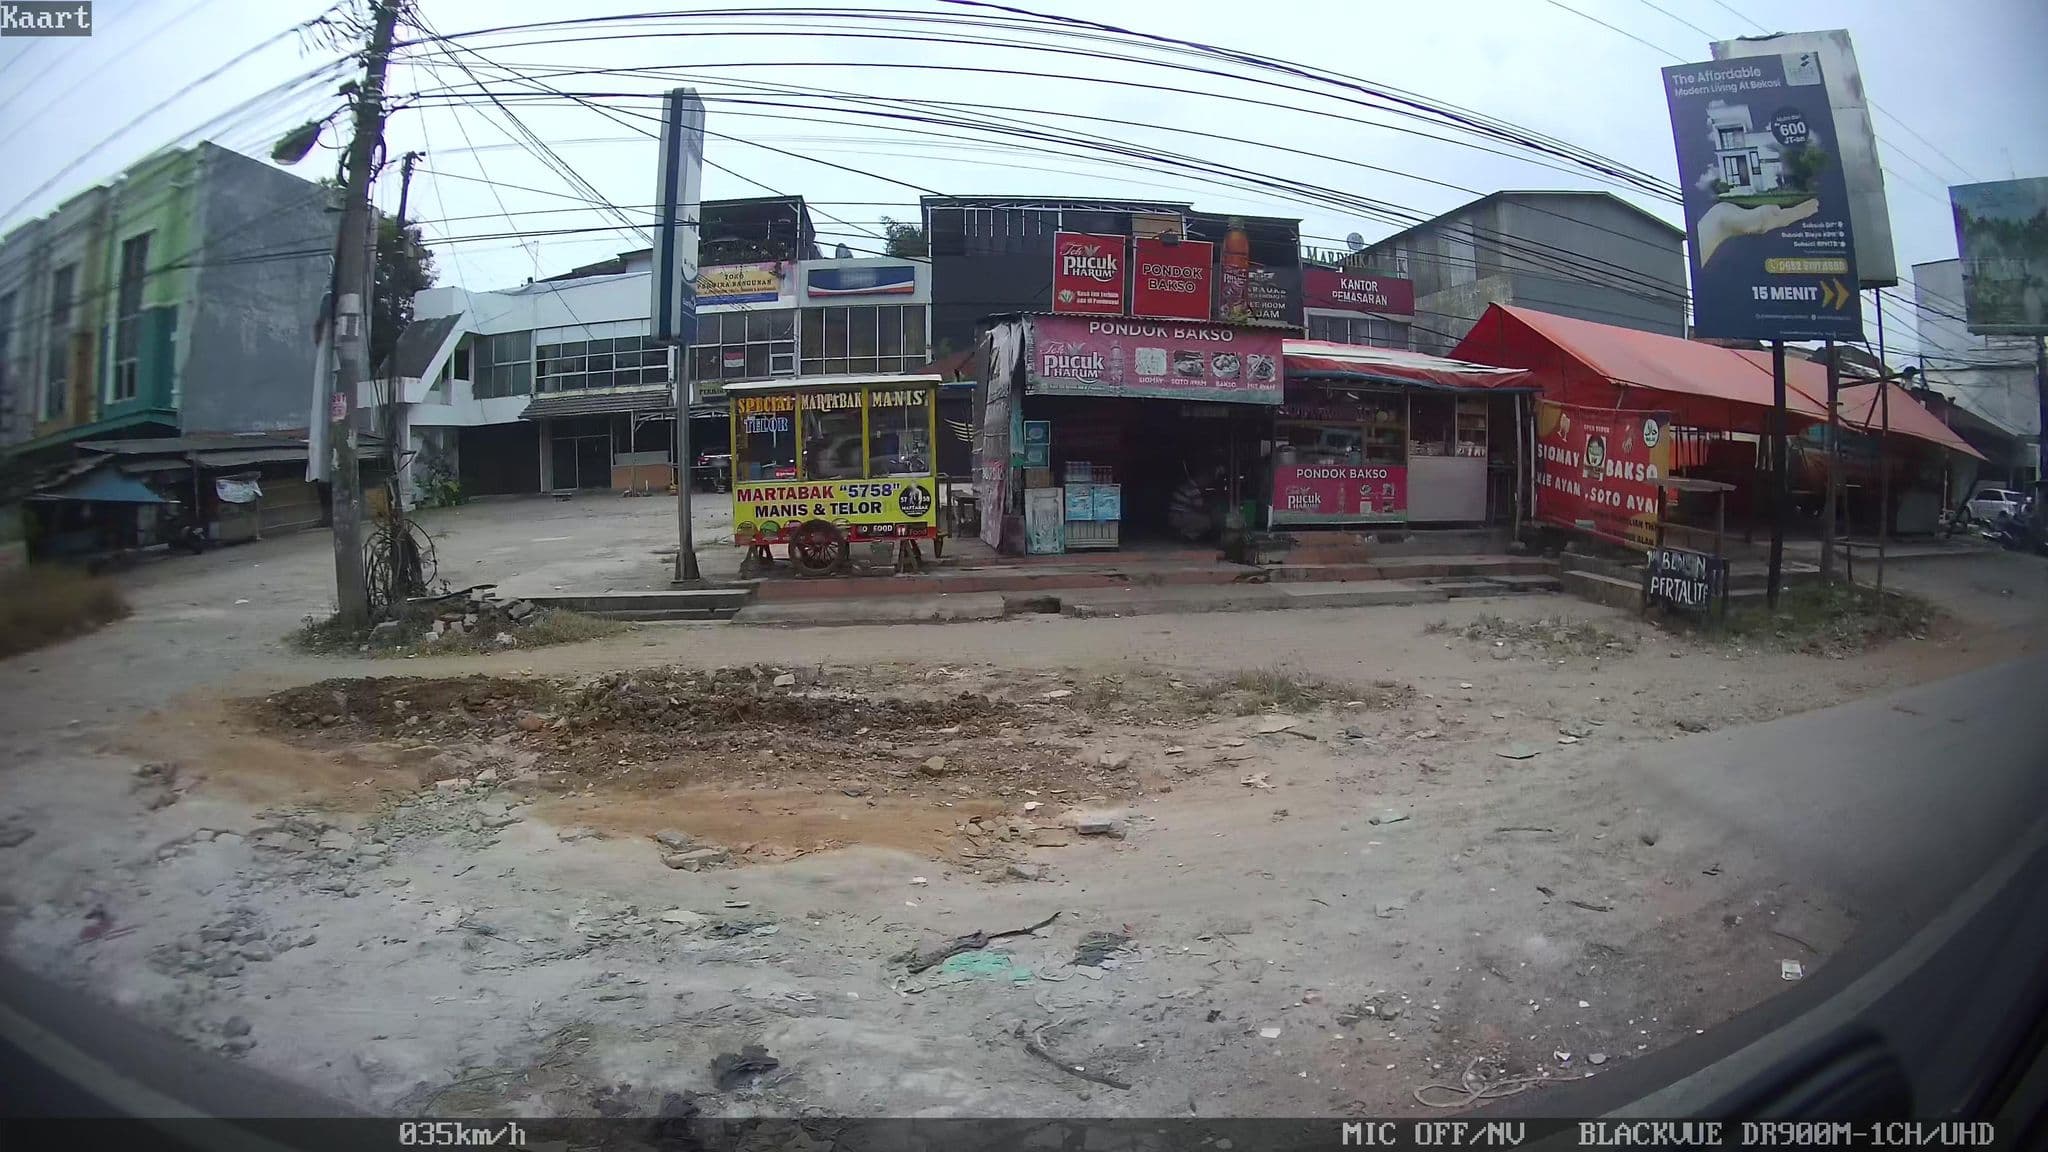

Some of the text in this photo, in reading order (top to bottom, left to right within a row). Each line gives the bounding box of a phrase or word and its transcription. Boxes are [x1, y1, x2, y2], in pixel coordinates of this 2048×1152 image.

[1671, 66, 1762, 86] The Affordable
[1674, 86, 1710, 97] Modern
[1711, 83, 1738, 94] Living
[1751, 79, 1782, 88] Bekasi
[1780, 121, 1806, 136] 600
[1060, 244, 1083, 256] Teh
[1063, 254, 1118, 275] pucuk
[1143, 264, 1203, 280] PONDOK
[1072, 268, 1113, 279] HARUM
[1149, 279, 1196, 293] BAKSO
[1340, 278, 1379, 292] KANTOR
[1752, 286, 1818, 300] 15 MENIT
[1332, 291, 1388, 305] PEMASARAN
[1255, 310, 1280, 319] JAM
[1089, 321, 1234, 343] PONDOK BAKSO
[1044, 352, 1105, 377] pucuk
[1053, 368, 1099, 379] HARUM
[738, 390, 925, 414] SPECIAL MARTABAK MANIS
[744, 417, 788, 434] TELOR
[1537, 444, 1658, 482] SIOMAY BAKSO
[1296, 468, 1387, 479] PONDOK BAKSO
[737, 486, 834, 502] MARTABAK
[1554, 477, 1581, 497] AYAM
[1288, 492, 1321, 509] pucuk
[755, 502, 882, 518] MANIS & TELOR
[873, 524, 893, 532] FOOD
